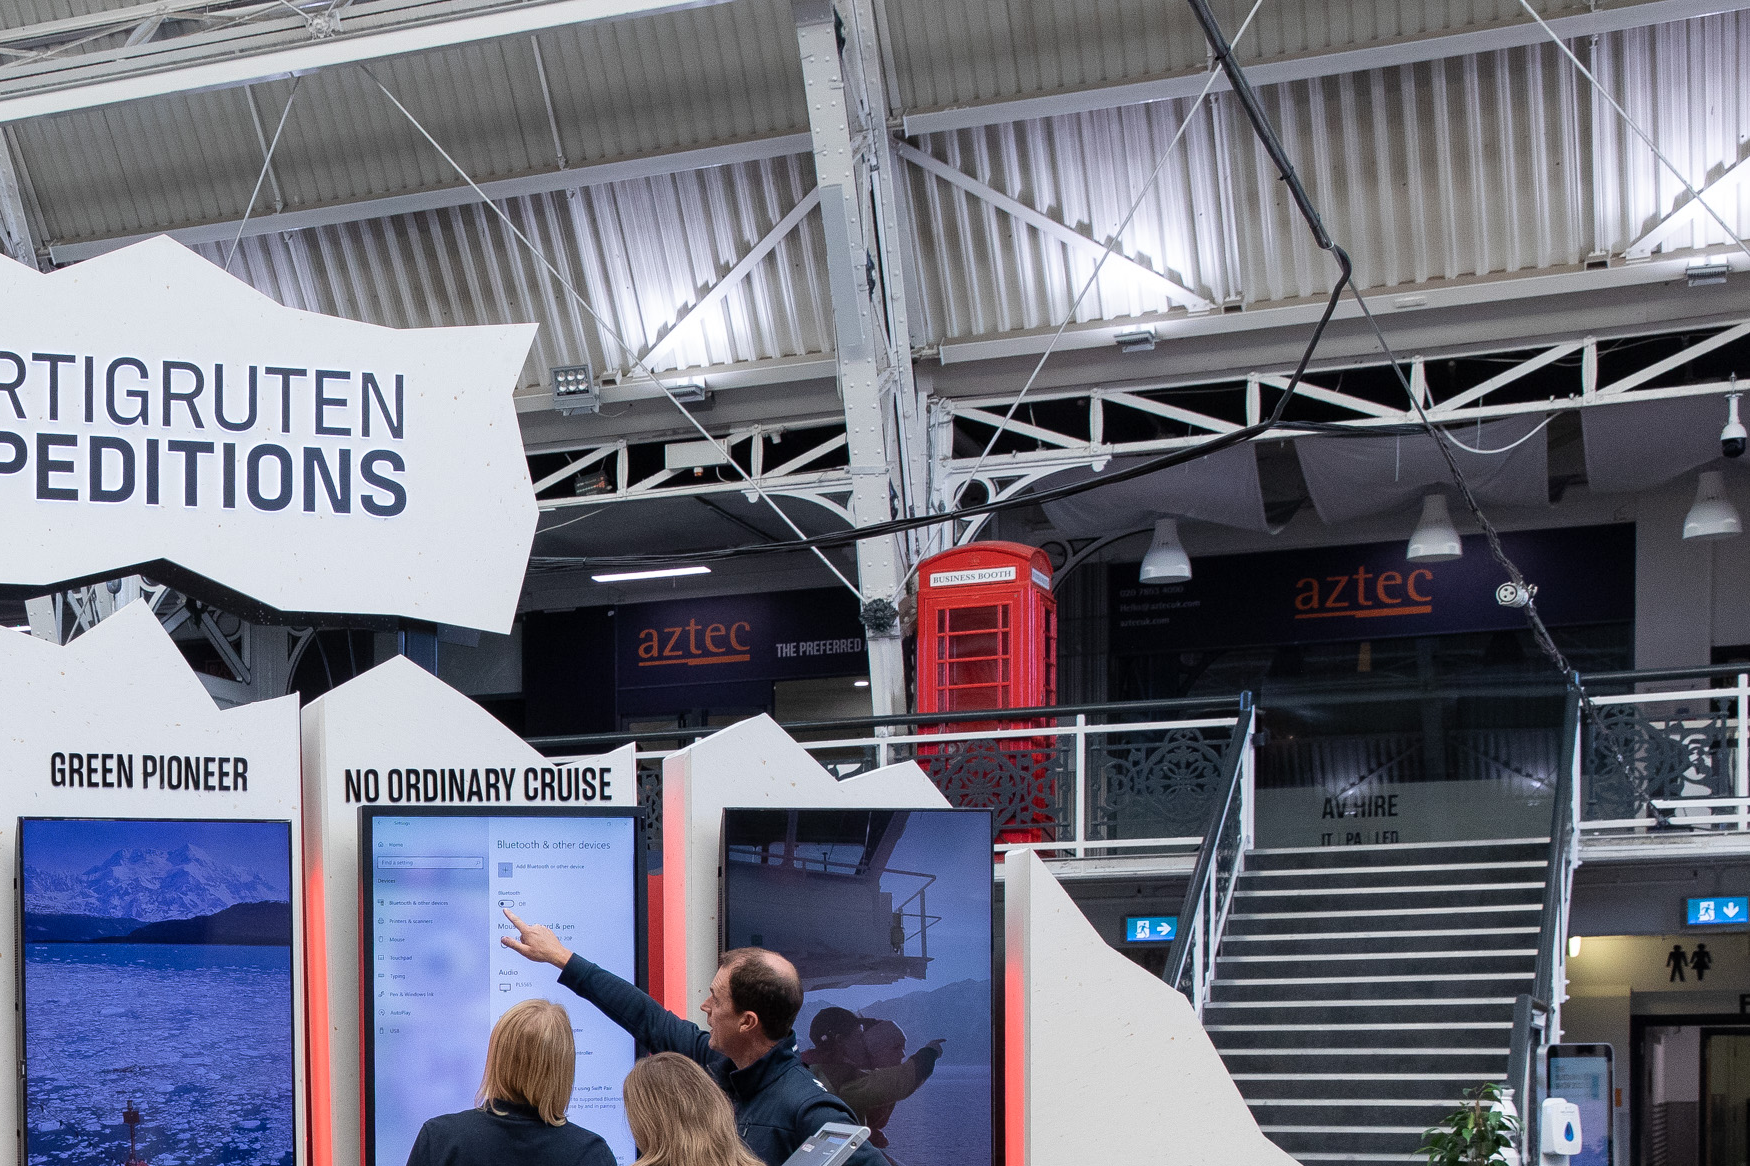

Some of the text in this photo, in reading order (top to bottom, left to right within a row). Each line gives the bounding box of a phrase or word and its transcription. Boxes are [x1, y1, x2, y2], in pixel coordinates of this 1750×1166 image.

[933, 570, 1011, 584] BUSINESS BOOTH
[1295, 565, 1433, 610] aztec
[638, 618, 750, 658] aztec
[776, 643, 796, 657] THE
[800, 638, 861, 655] PREFERRED
[50, 752, 249, 792] GREEN PIONEER
[345, 767, 612, 802] NO ORDINARY CRUISE
[1322, 795, 1399, 819] AV HIRE
[497, 840, 611, 849] Bluetooth & other devices
